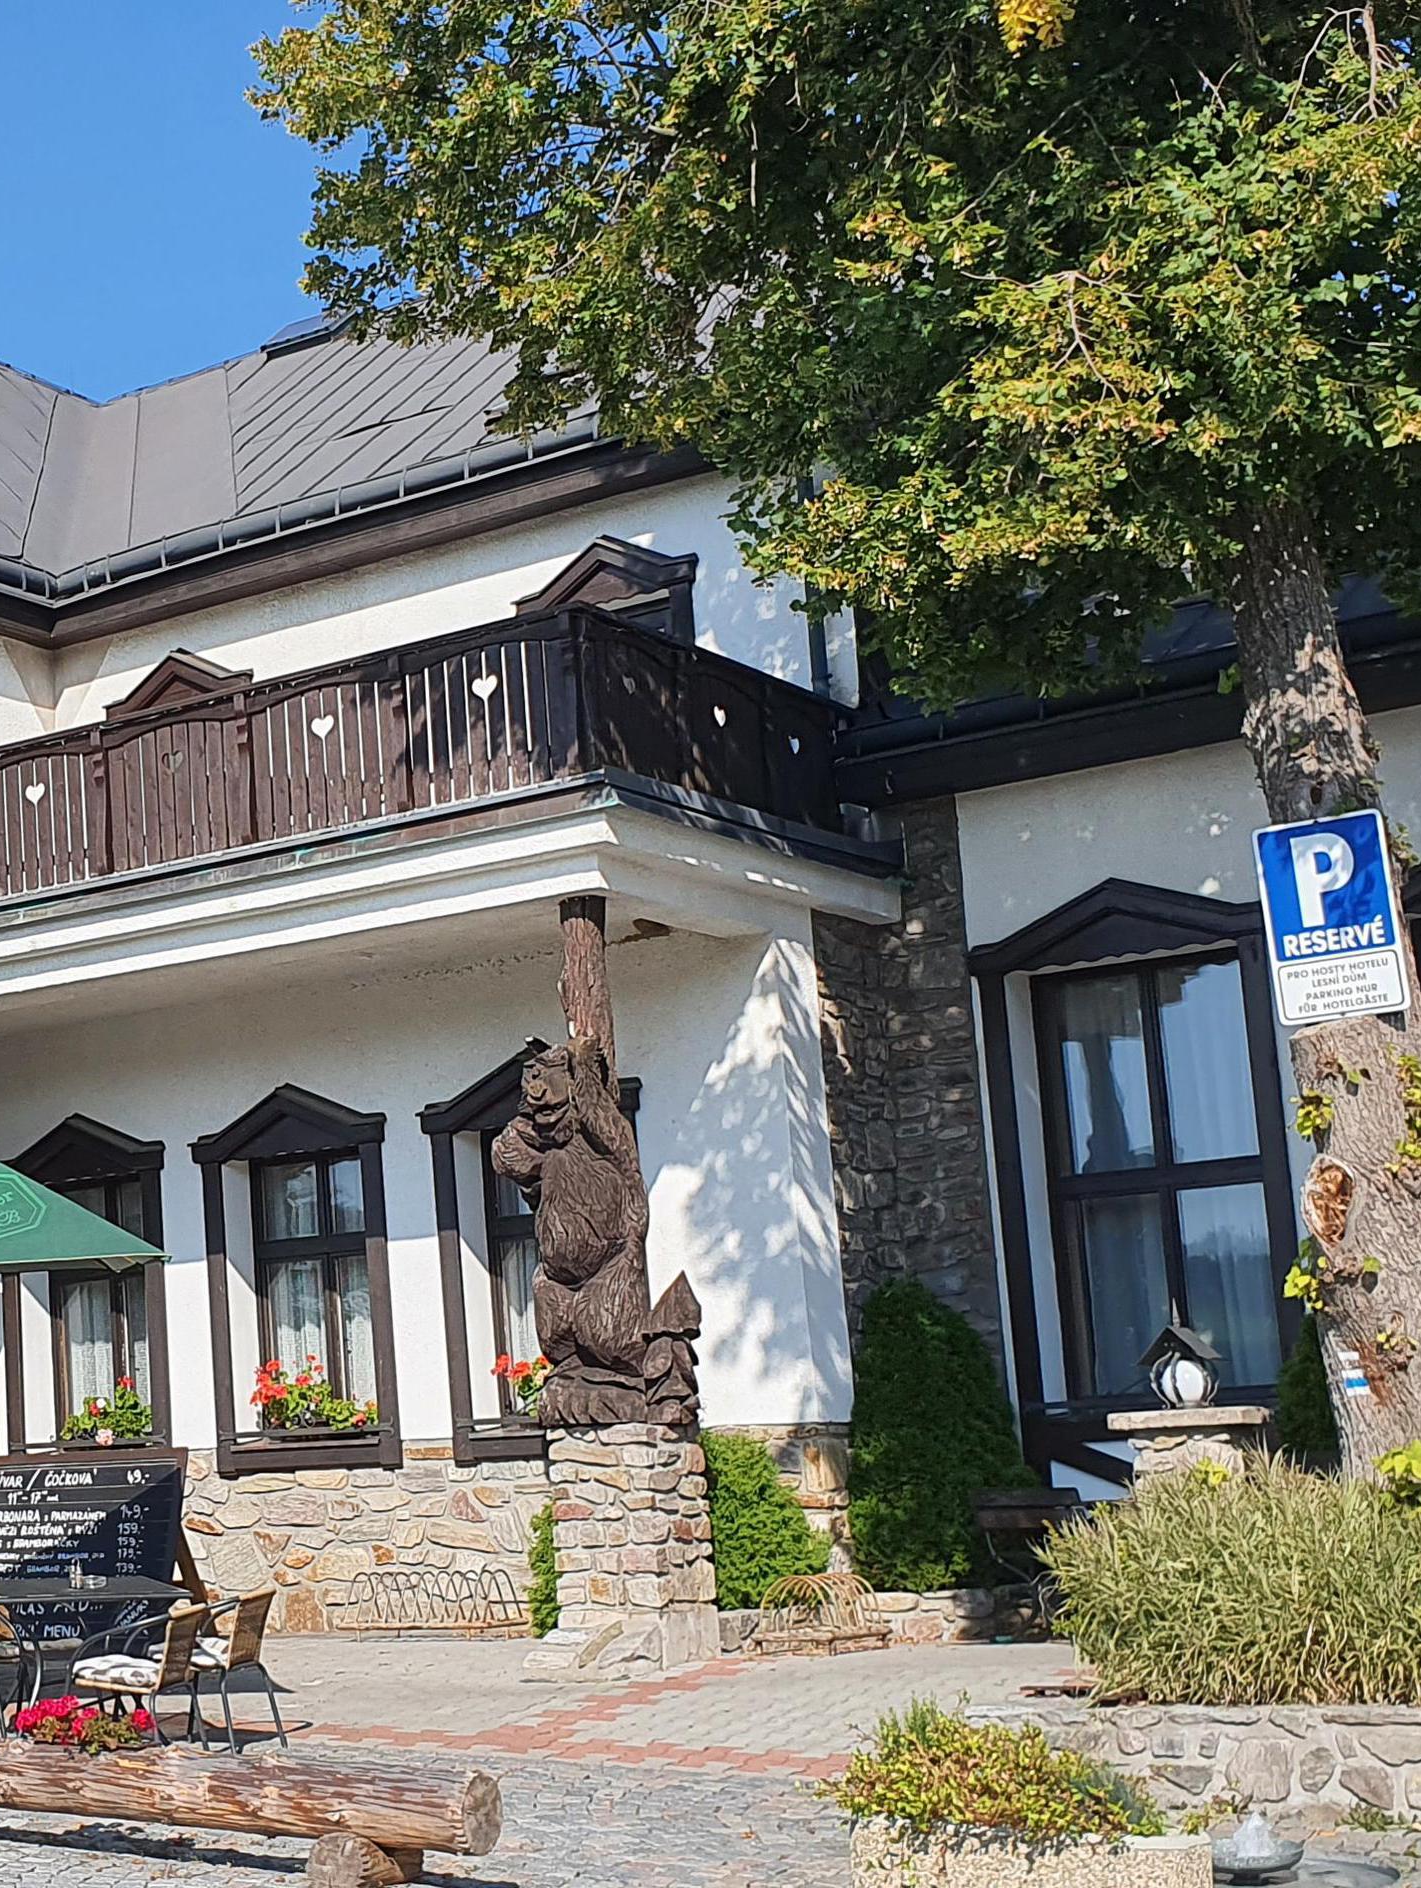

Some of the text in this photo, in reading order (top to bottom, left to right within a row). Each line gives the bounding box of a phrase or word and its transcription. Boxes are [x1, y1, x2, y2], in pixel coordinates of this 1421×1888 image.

[1289, 832, 1355, 928] P
[1283, 915, 1386, 957] RESERVÉ
[1287, 958, 1389, 980] PRO HOSTY HOTELU
[1312, 969, 1368, 988] LESNÍ DŮM
[1306, 983, 1378, 1001] PARKING NUR
[1298, 1002, 1318, 1014] FÜR
[44, 1468, 97, 1488] ČOČKOVÁ
[43, 1624, 81, 1638] MENU
